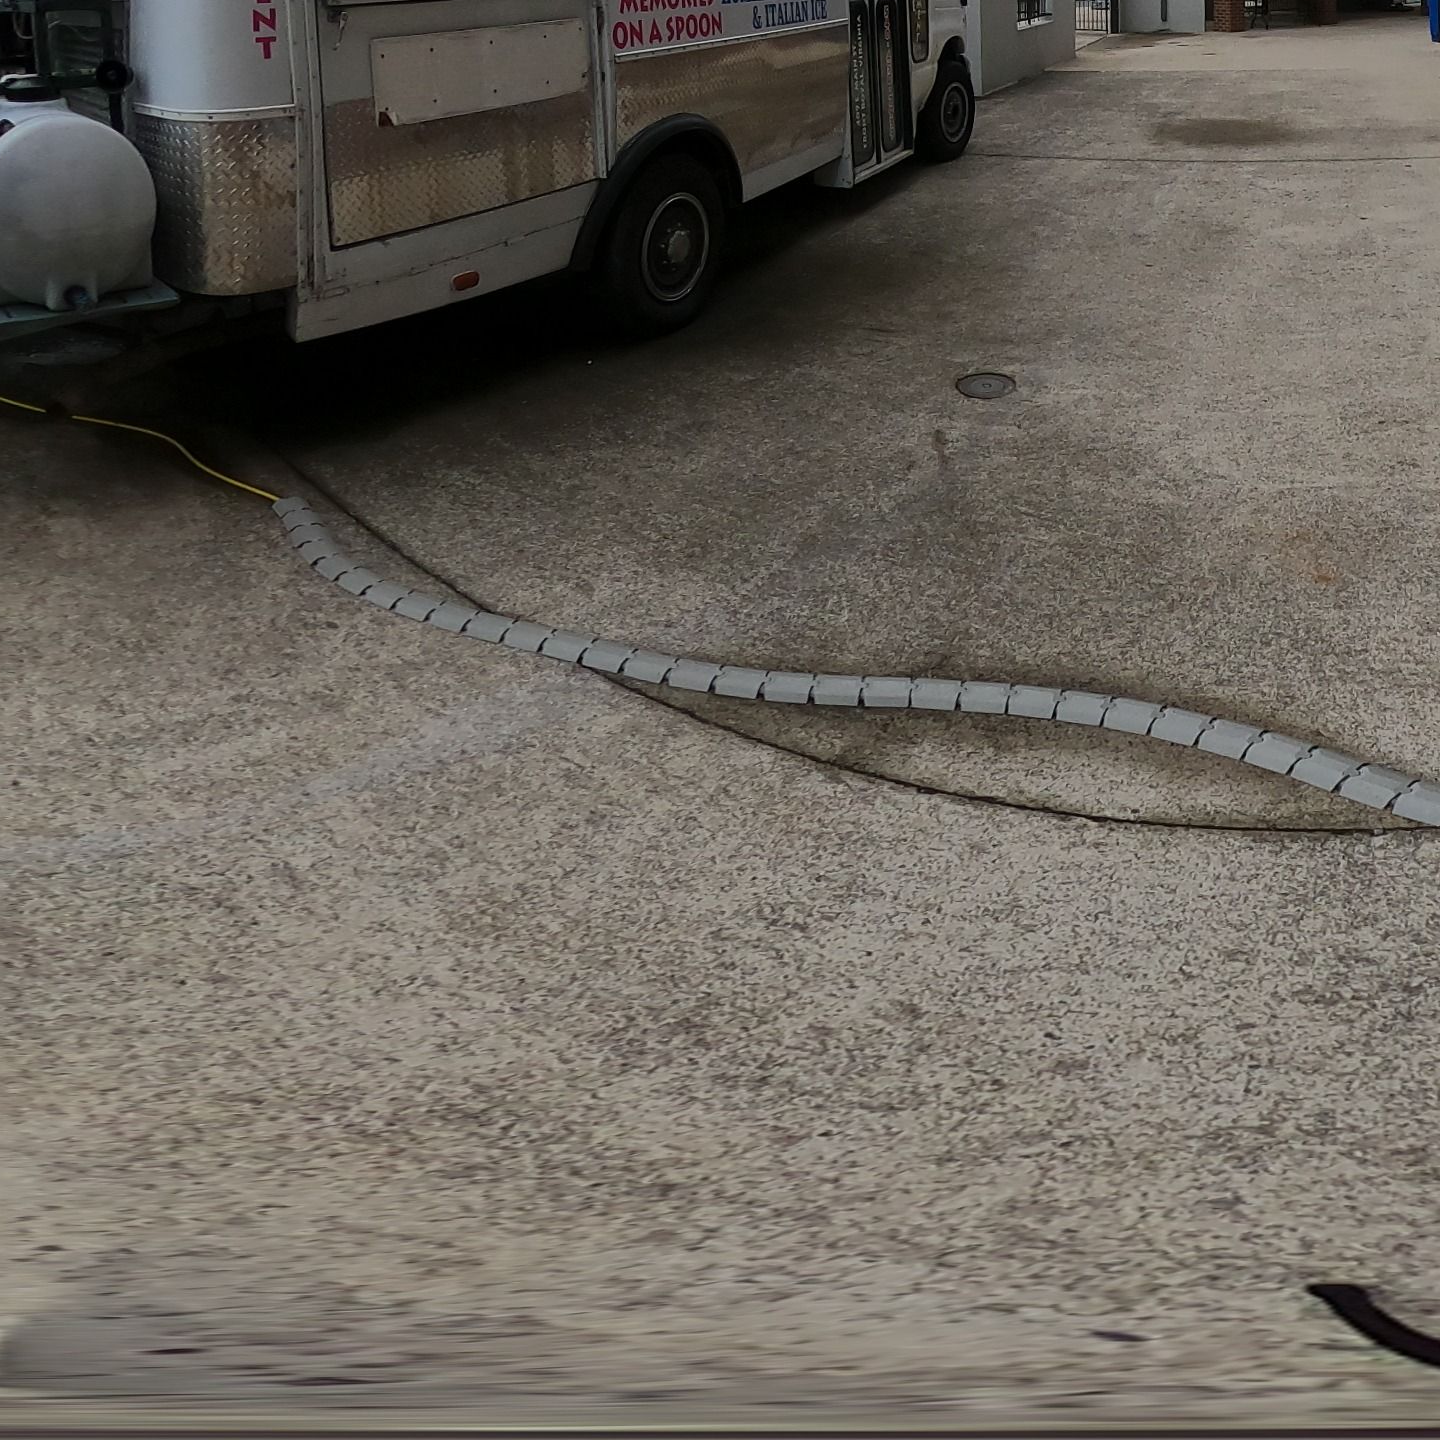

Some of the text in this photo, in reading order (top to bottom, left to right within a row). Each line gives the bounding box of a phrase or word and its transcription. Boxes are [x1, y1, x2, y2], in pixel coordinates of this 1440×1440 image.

[612, 11, 724, 50] ON A SPOON
[752, 5, 762, 30] &
[765, 1, 810, 28] ITALIAN
